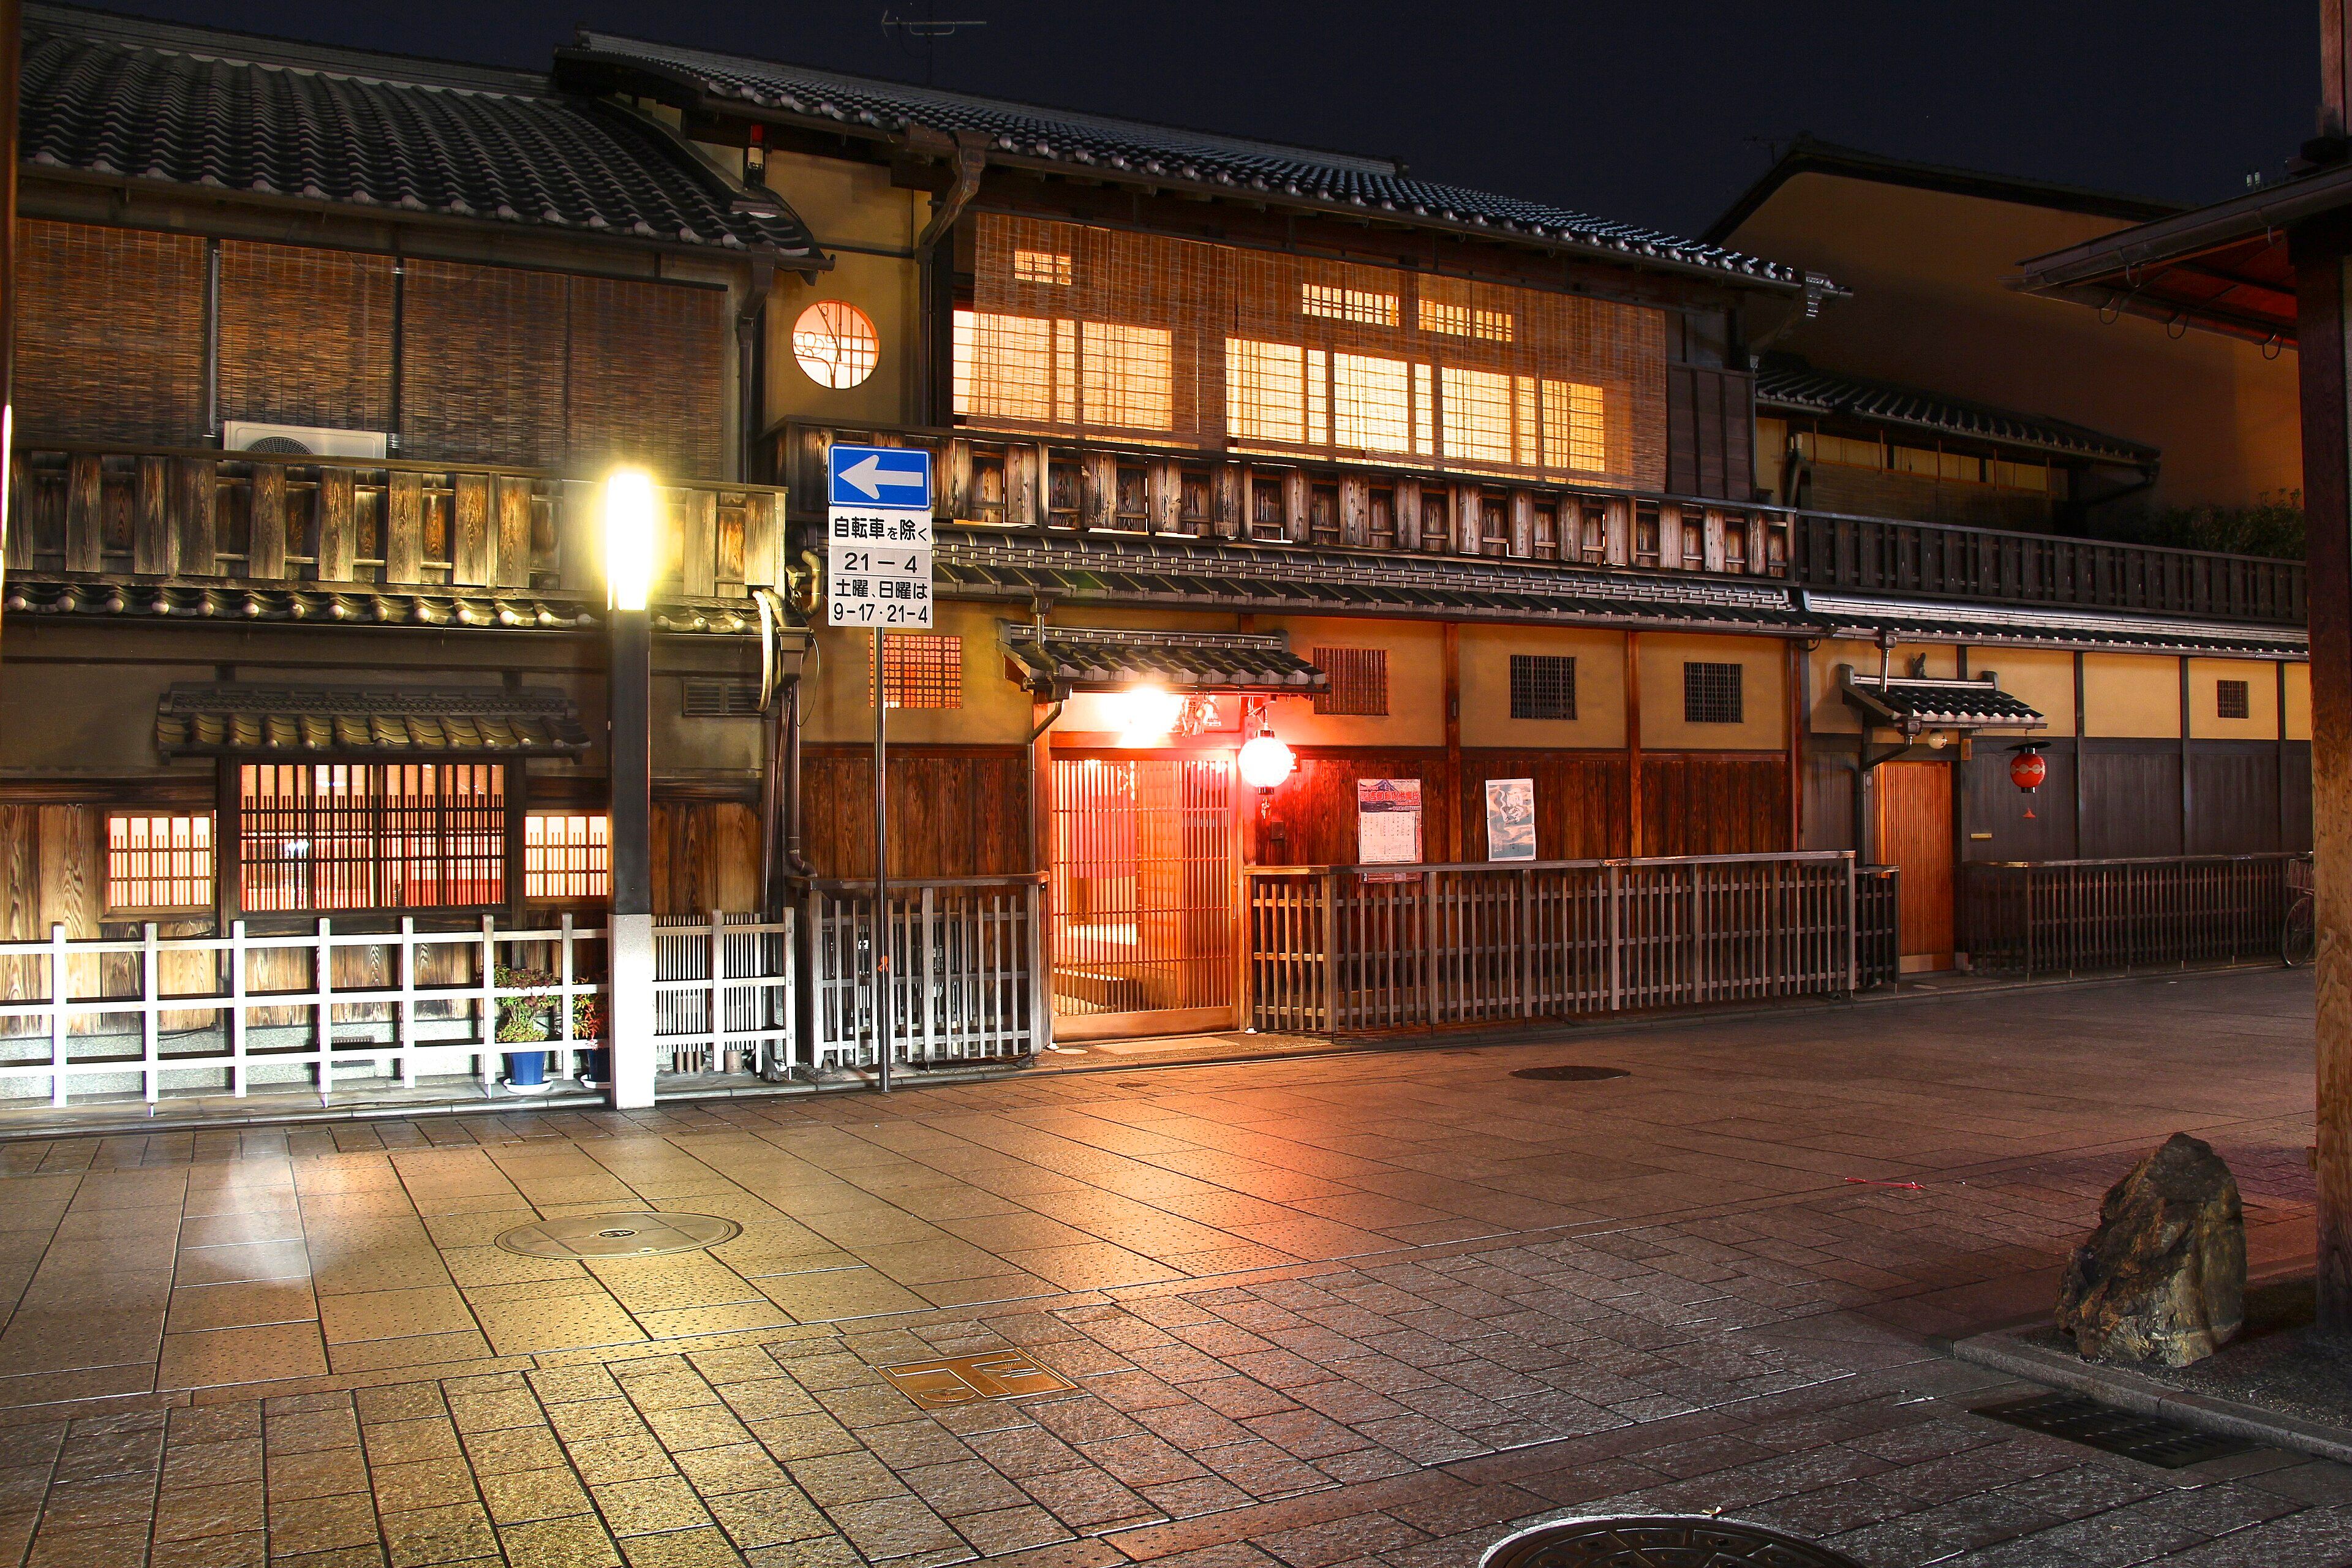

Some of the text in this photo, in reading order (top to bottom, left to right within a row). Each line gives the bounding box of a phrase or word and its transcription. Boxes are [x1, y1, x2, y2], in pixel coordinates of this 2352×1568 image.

[834, 516, 927, 541] 自転車を除く
[834, 578, 928, 600] 土曜、日曜は
